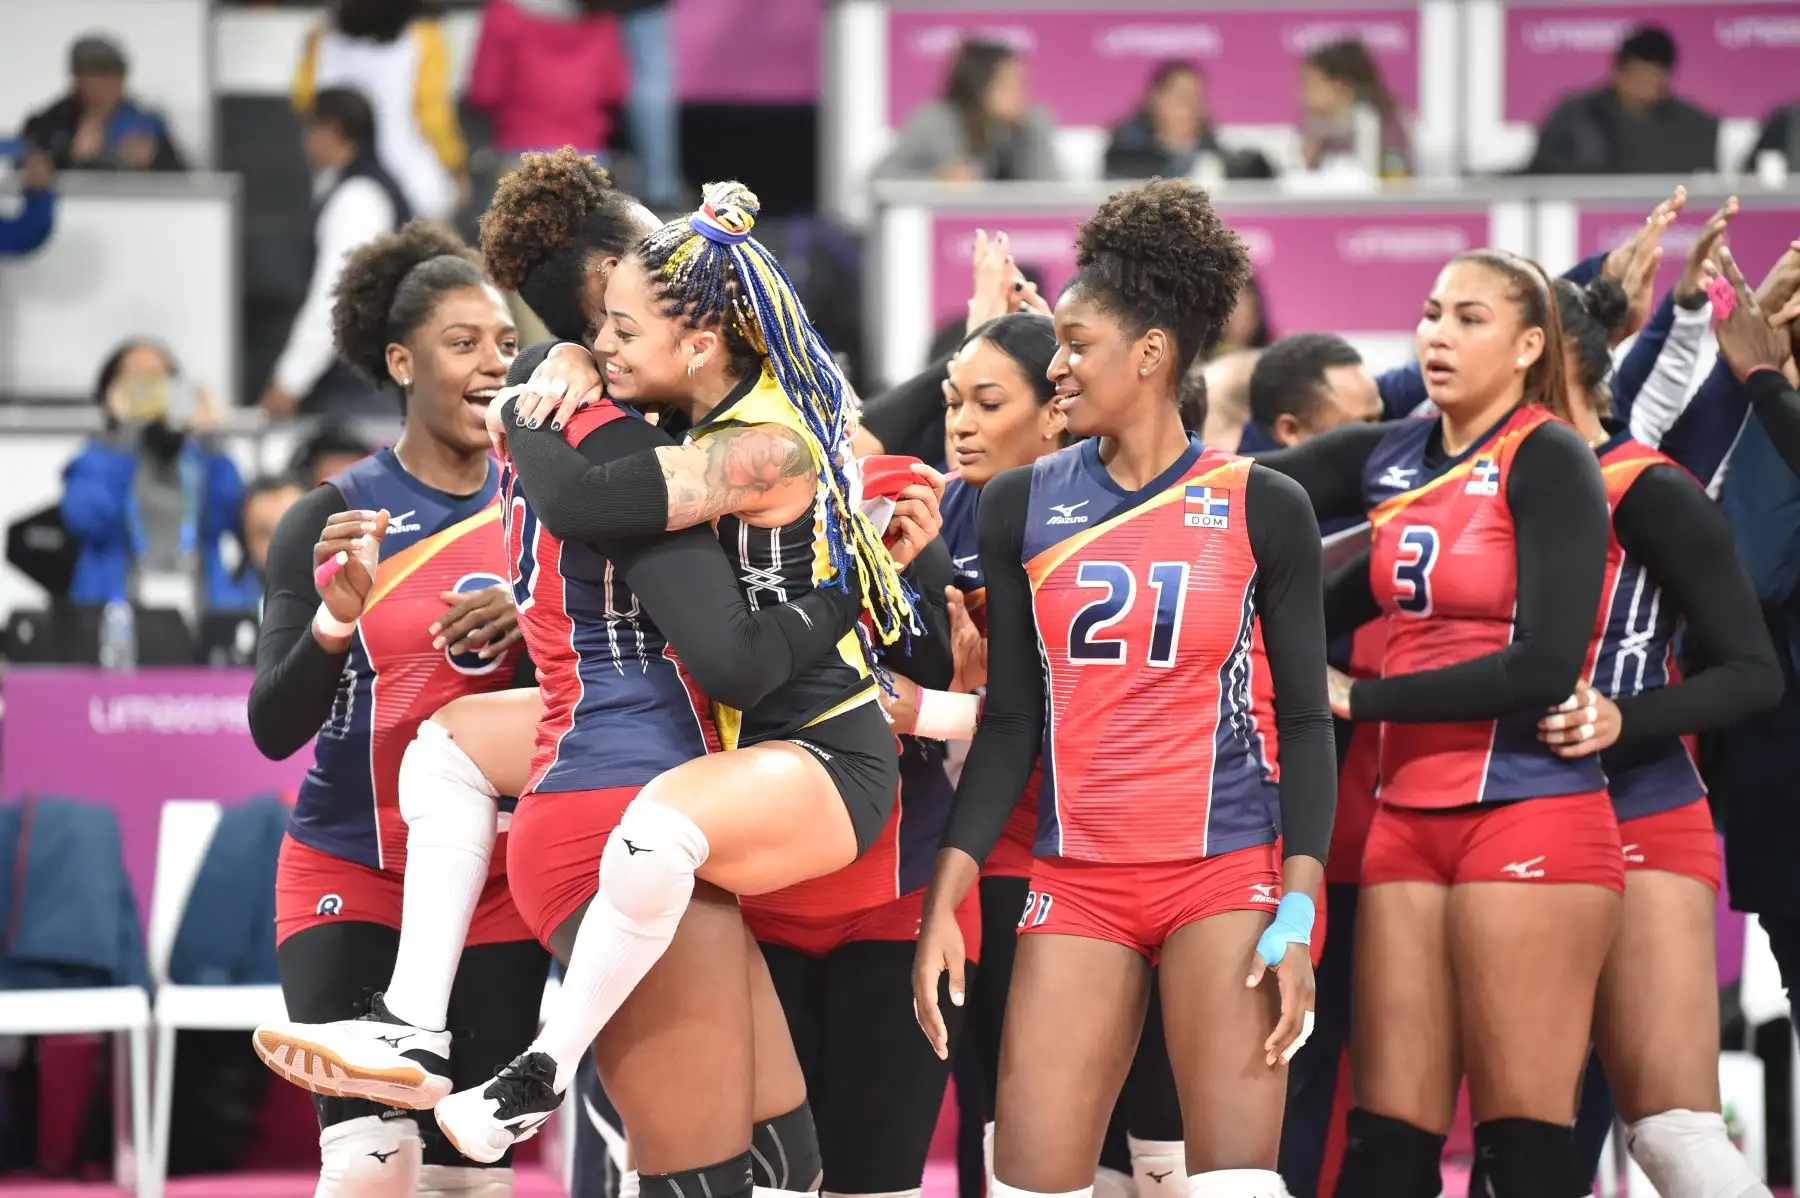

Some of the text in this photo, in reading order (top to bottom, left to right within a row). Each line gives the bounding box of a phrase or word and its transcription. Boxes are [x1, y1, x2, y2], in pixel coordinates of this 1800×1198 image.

[1191, 516, 1223, 526] DOM
[1067, 560, 1191, 668] 21
[1392, 524, 1440, 619] 3
